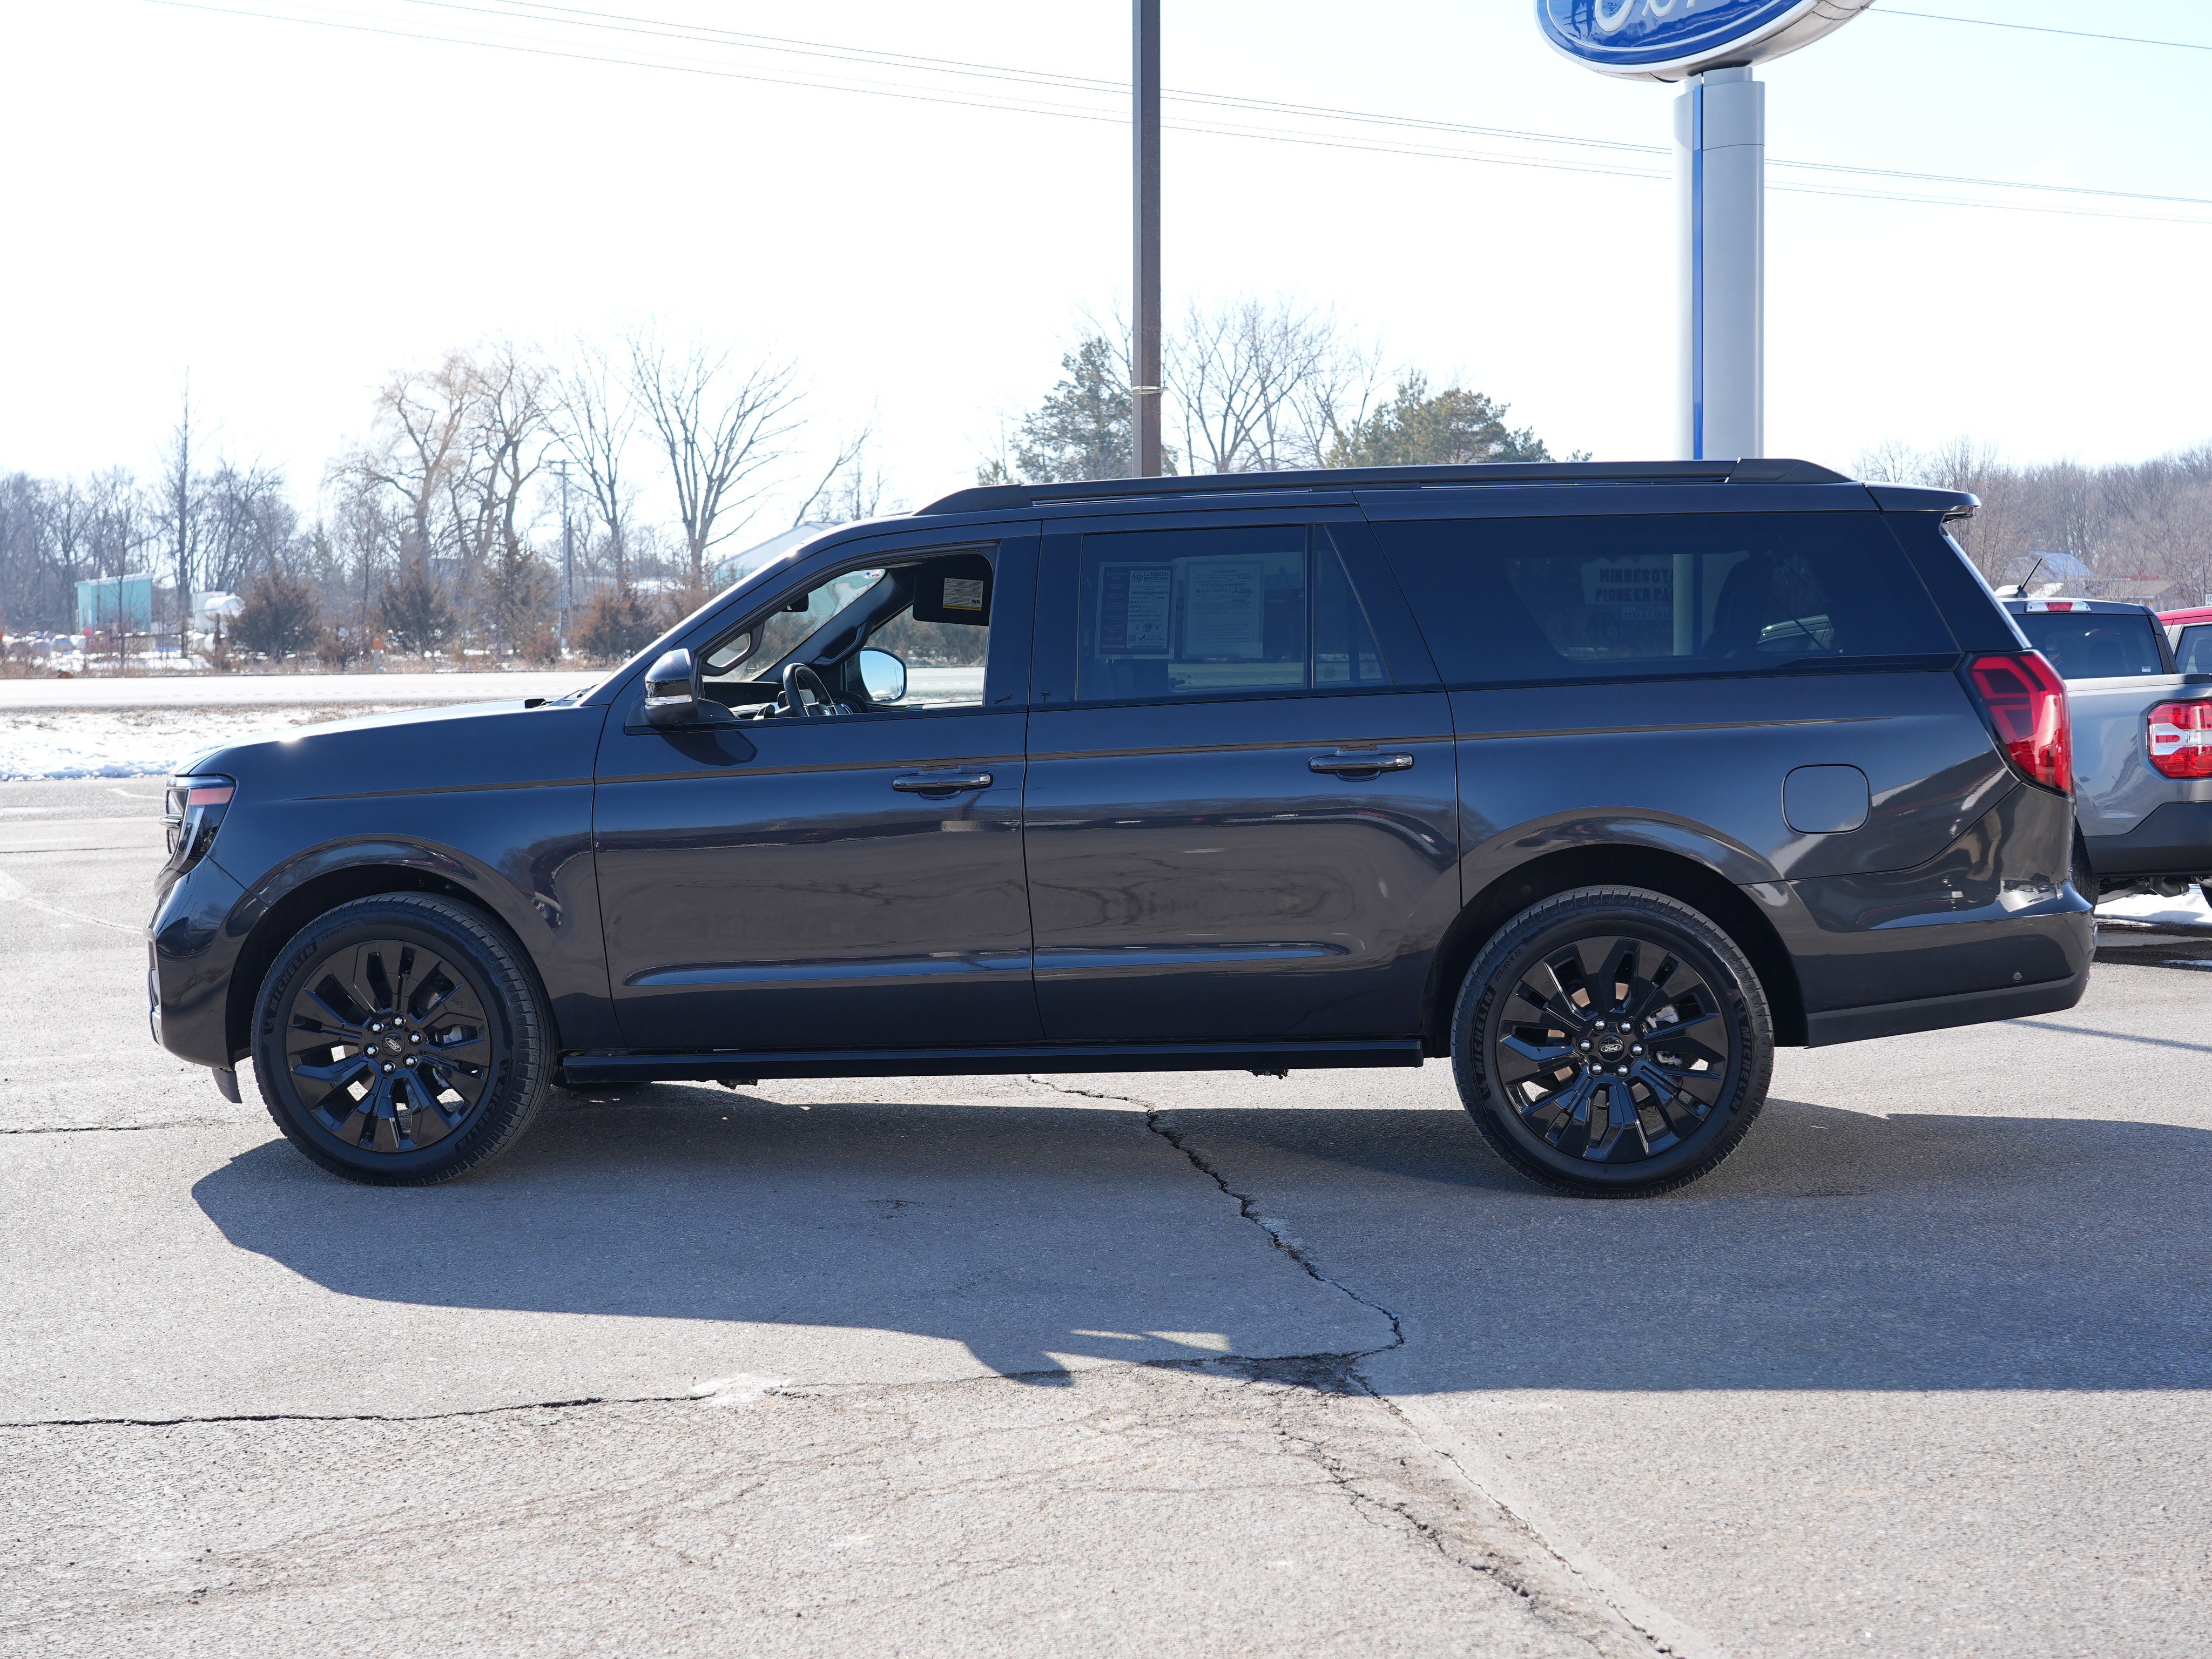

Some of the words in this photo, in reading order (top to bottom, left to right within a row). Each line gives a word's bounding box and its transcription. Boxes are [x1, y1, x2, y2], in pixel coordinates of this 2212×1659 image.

[1596, 588, 1650, 602] PIONEER
[1623, 611, 1671, 619] MUSEUM
[321, 925, 348, 941] PRIMACY
[270, 944, 314, 1012] MICHELIN
[1494, 961, 1510, 982] 275/50
[1515, 949, 1522, 957] 22
[1473, 990, 1493, 1074] MICHELIN
[1731, 1026, 1751, 1110] MICHELIN
[458, 1082, 504, 1149] MICHELIN
[1709, 1119, 1731, 1147] PRIMACY
